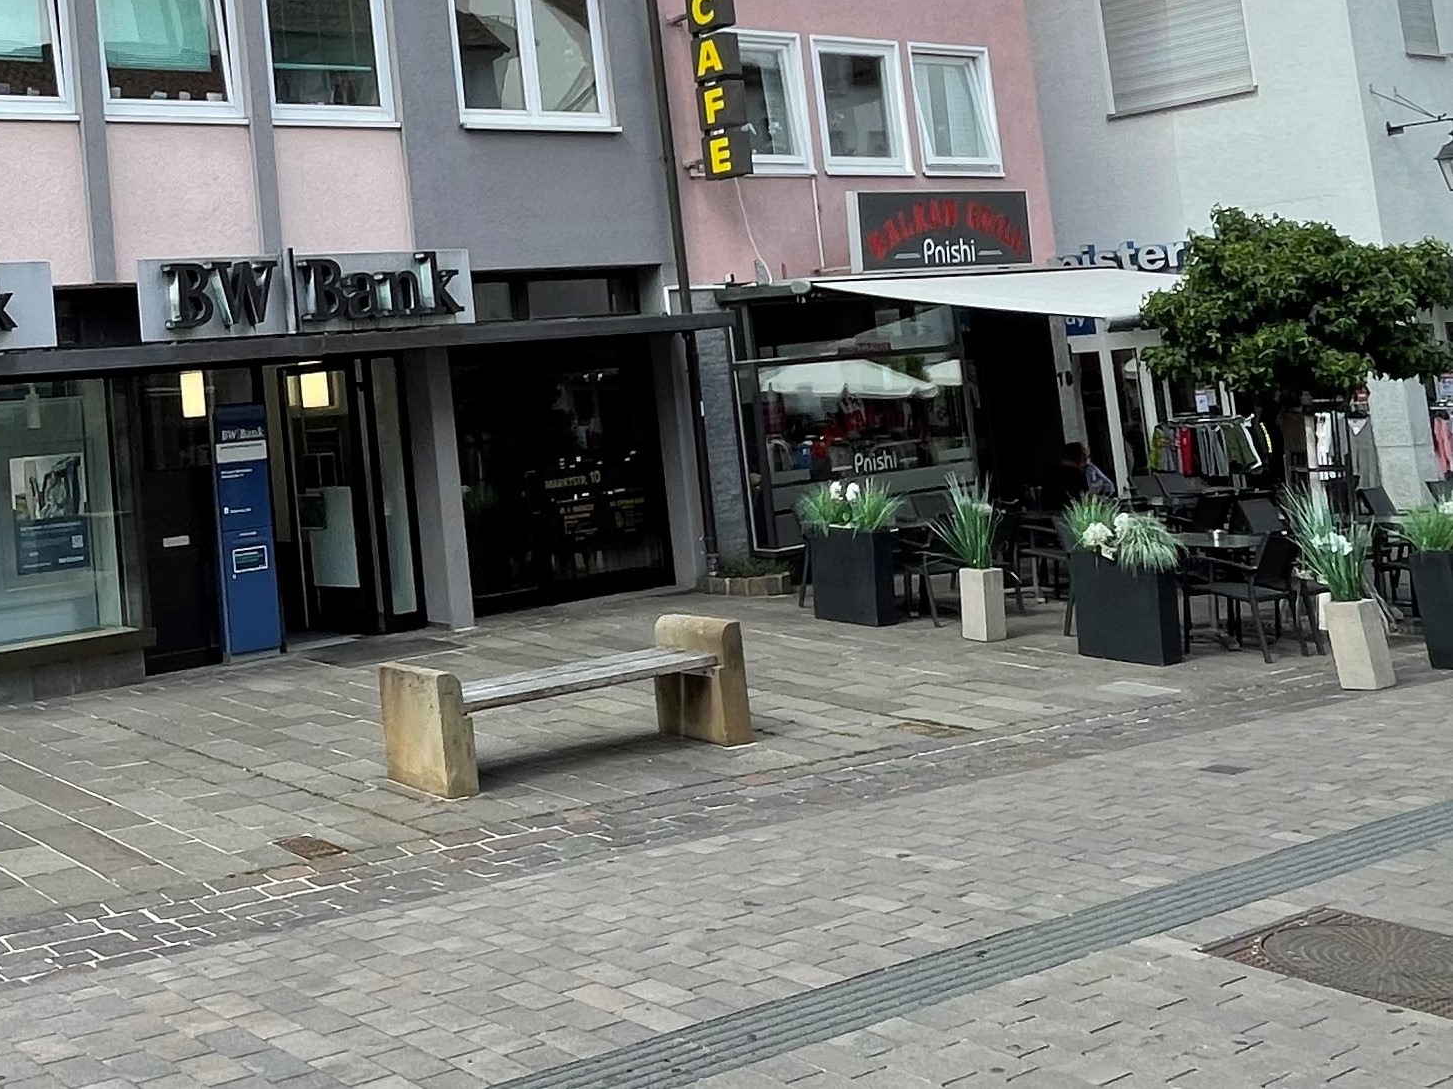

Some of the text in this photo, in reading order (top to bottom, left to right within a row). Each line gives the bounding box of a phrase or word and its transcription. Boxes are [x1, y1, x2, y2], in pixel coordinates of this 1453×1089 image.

[922, 237, 977, 265] Pnishi
[160, 251, 465, 331] BW Bank
[853, 449, 898, 474] Pnishi
